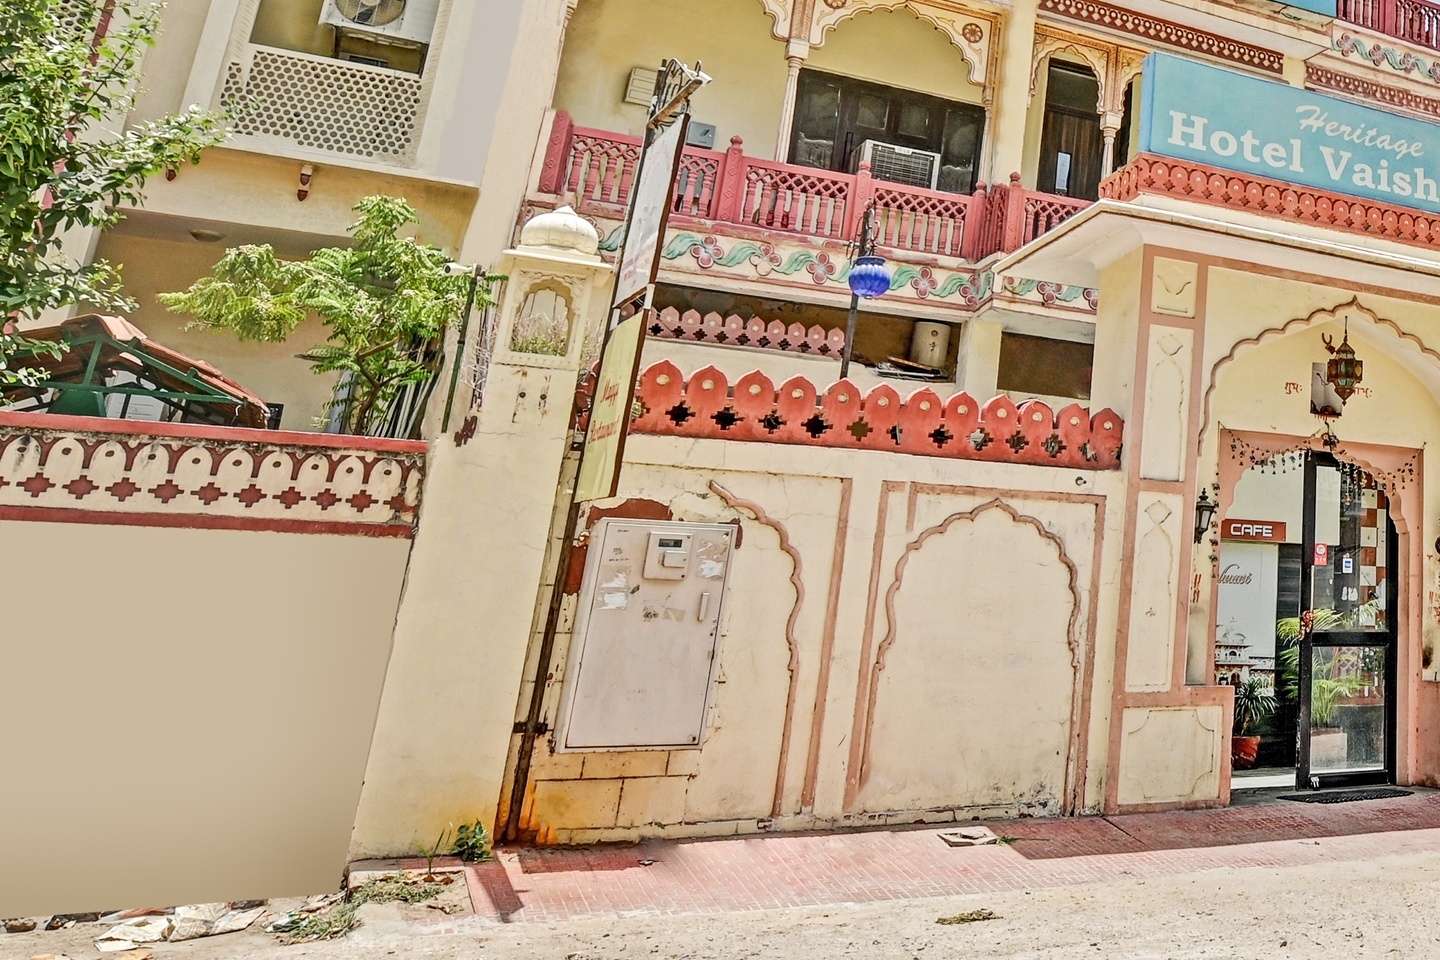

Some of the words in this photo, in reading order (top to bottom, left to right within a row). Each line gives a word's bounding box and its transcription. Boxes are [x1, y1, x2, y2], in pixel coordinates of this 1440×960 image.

[1167, 110, 1304, 173] Hotel
[1295, 105, 1424, 160] Heritage
[1230, 523, 1273, 538] CAFE
